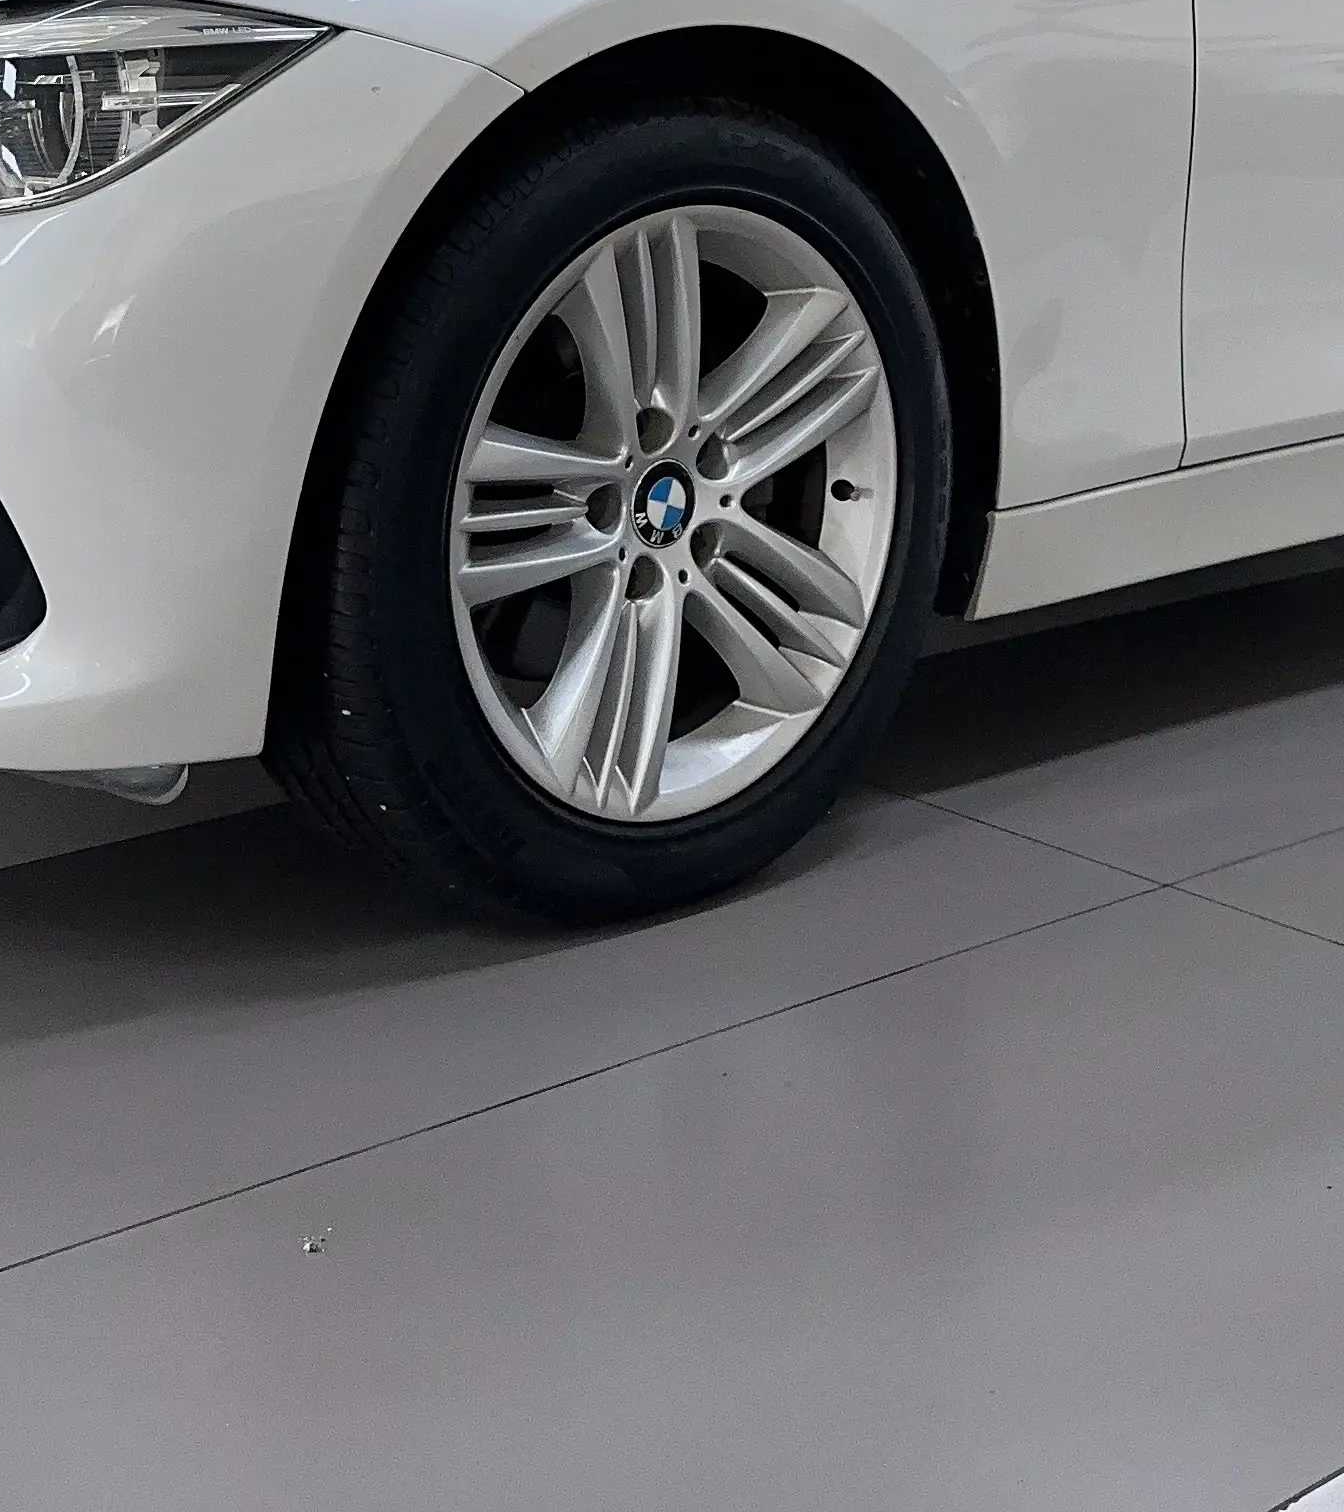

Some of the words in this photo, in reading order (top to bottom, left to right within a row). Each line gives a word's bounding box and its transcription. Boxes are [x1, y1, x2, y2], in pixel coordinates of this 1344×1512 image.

[202, 28, 229, 36] BMW
[231, 26, 252, 34] LED
[635, 512, 683, 545] BMW
